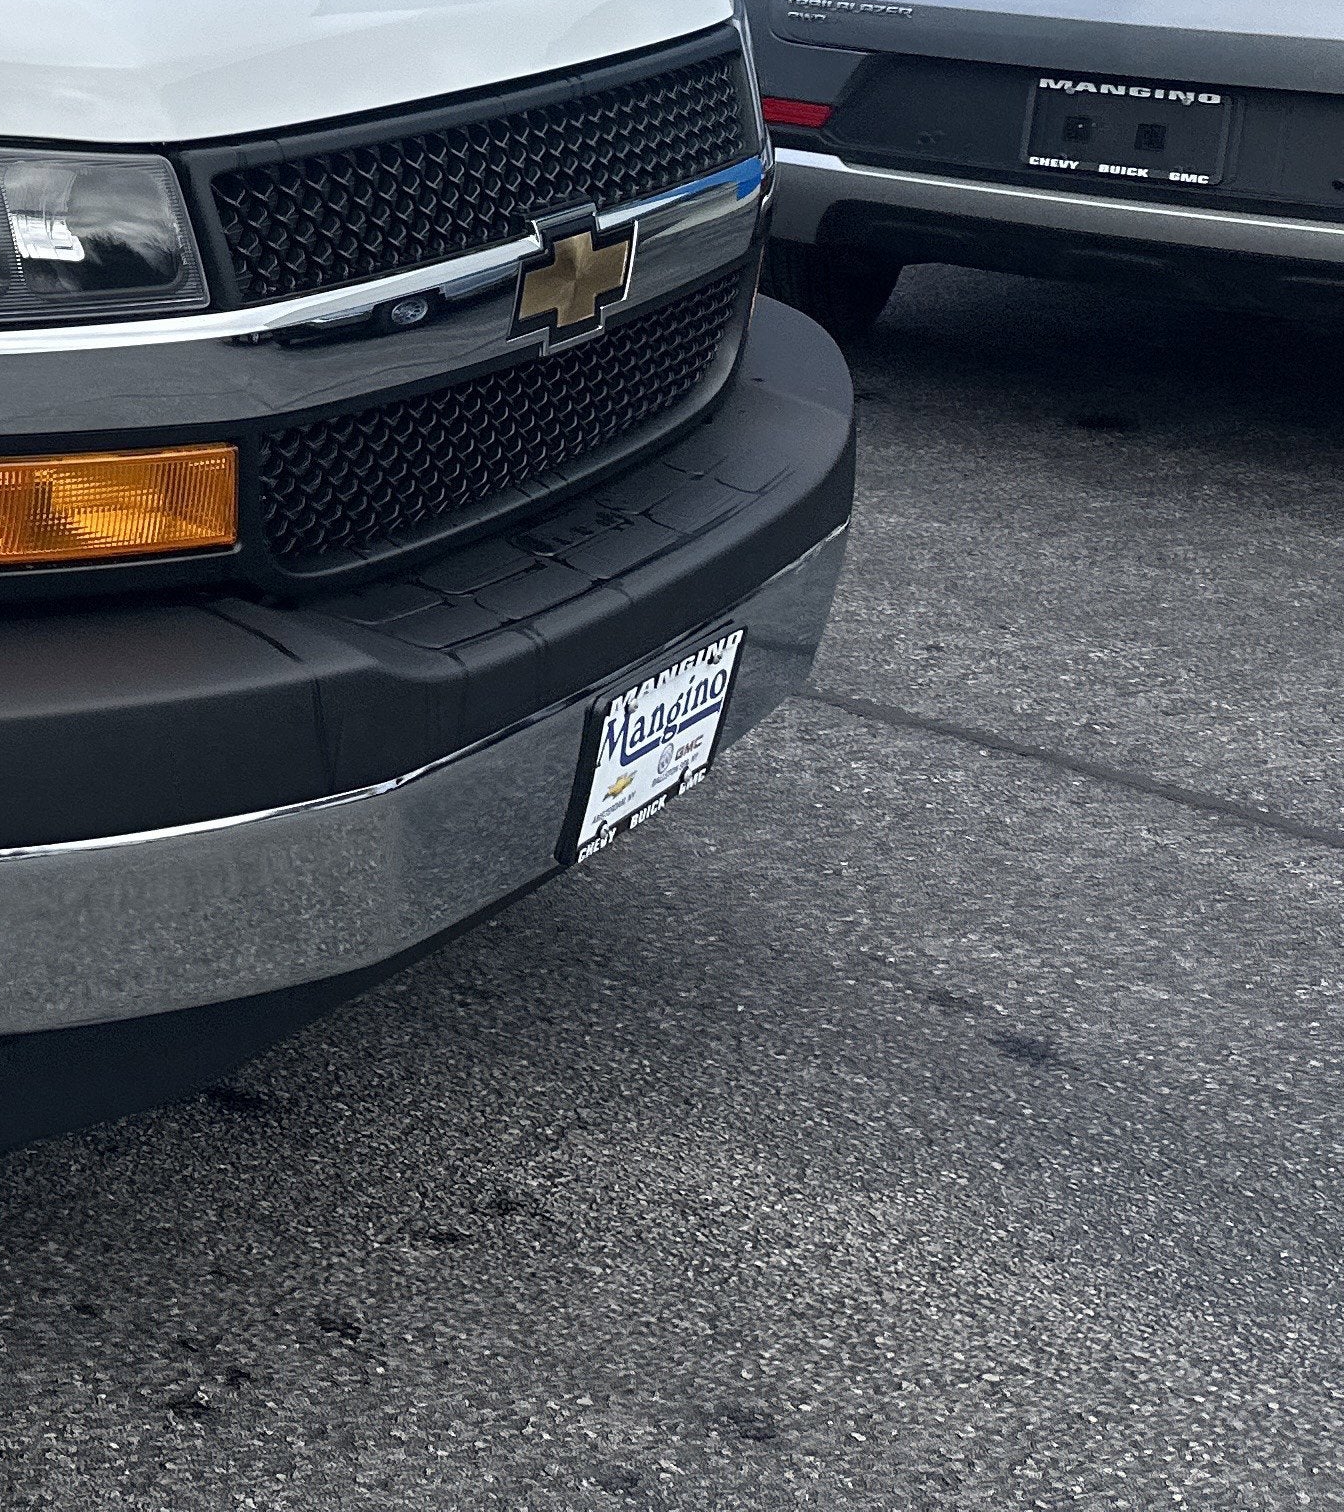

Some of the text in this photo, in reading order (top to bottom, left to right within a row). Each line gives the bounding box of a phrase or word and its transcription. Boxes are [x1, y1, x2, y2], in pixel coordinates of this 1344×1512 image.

[1039, 78, 1221, 105] MANGINO
[1029, 156, 1209, 185] CHEVY BUICK GMC
[610, 629, 744, 716] MANGINO
[596, 669, 727, 766] Mangino
[675, 734, 704, 761] GMC
[629, 794, 667, 829] BUICK
